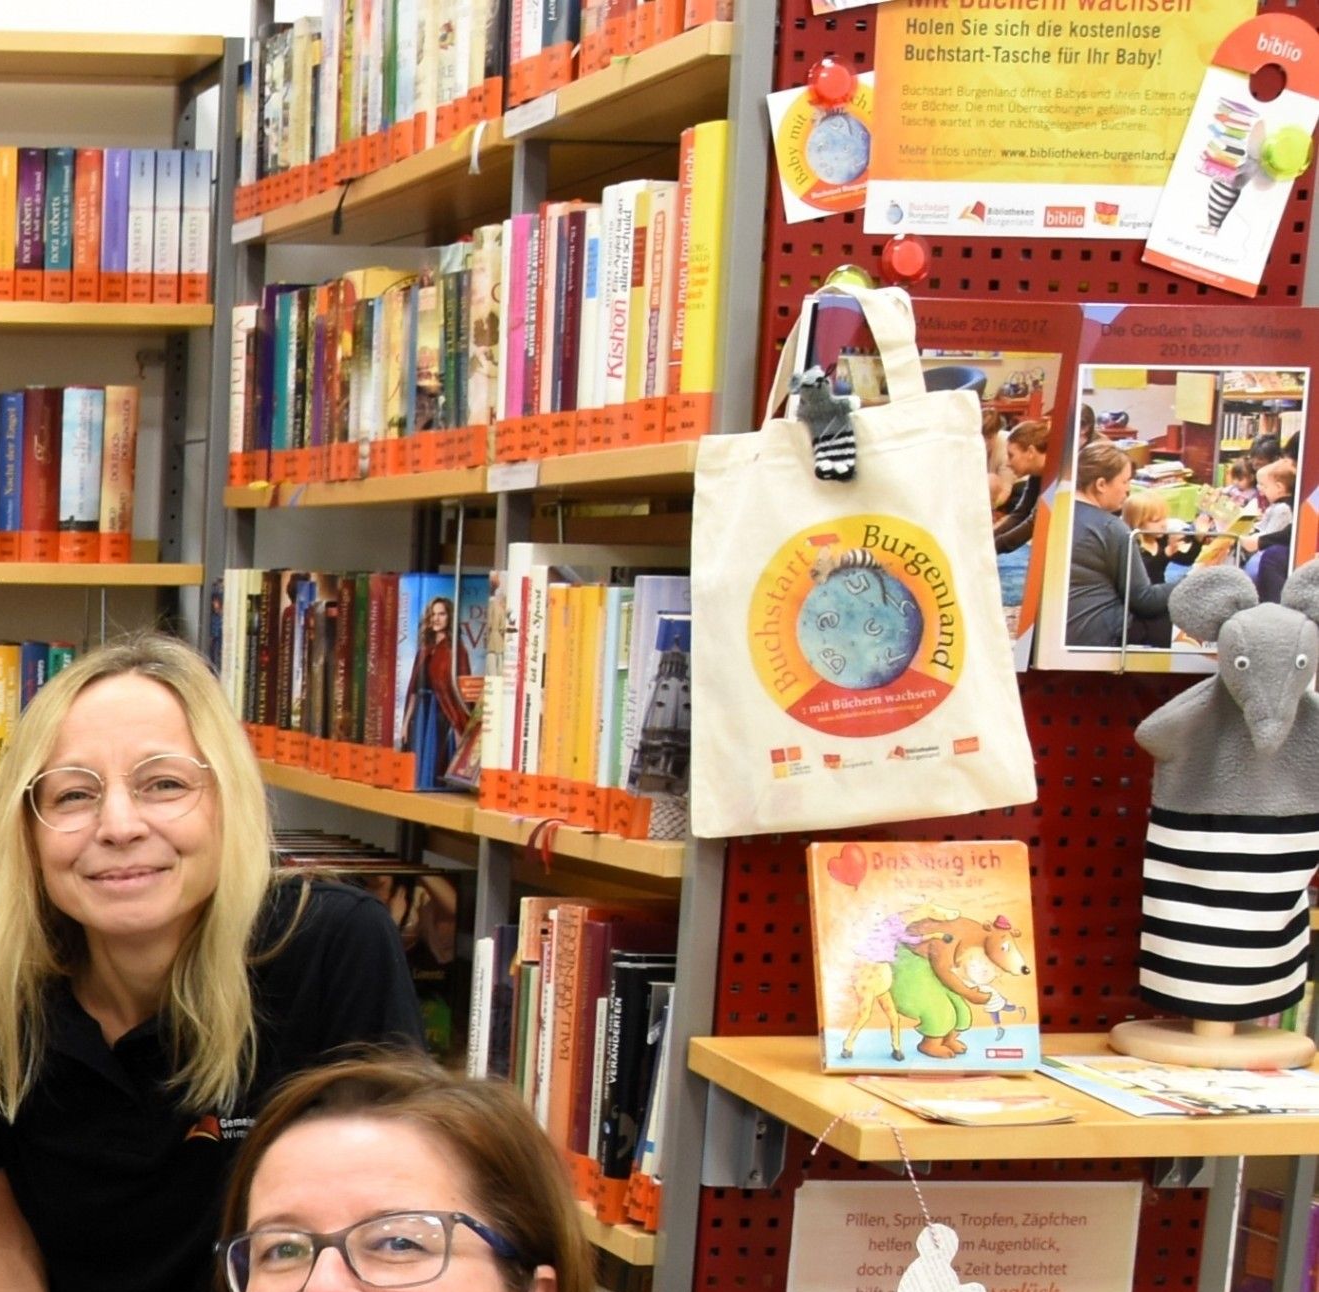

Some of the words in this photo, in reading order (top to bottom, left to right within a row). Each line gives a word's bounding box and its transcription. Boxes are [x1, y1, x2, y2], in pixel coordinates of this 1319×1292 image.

[905, 18, 955, 36] Holen
[960, 19, 988, 37] Sie
[994, 20, 1030, 38] sich
[1036, 20, 1062, 39] die
[1068, 21, 1162, 40] kostenlose
[904, 44, 1051, 64] Buchstart-Tasche
[1056, 46, 1080, 66] für
[1087, 47, 1109, 65] Ihr
[1116, 48, 1163, 70] Baby!
[1256, 32, 1303, 63] biblio
[902, 85, 952, 98] Buchstart
[957, 86, 1017, 99] Burgenland
[1055, 88, 1088, 102] Babys
[1090, 89, 1111, 100] und
[900, 101, 918, 112] der
[966, 102, 984, 113] Die
[987, 102, 1004, 113] mit
[1008, 101, 1094, 118] Überraschungen
[901, 115, 936, 128] Tasche
[939, 117, 972, 129] wartet
[976, 117, 986, 129] in
[988, 118, 1006, 129] der
[898, 144, 927, 157] Mehr
[931, 145, 960, 158] Infos
[788, 147, 810, 187] Baby
[22, 197, 32, 235] roberts
[50, 196, 60, 235] roberts
[76, 197, 87, 236] roberts
[986, 206, 1036, 217] Bibliotheken
[1045, 208, 1084, 227] biblio
[677, 193, 693, 262] trotzdem
[22, 239, 30, 263] nora
[50, 239, 59, 263] nora
[676, 267, 688, 303] man
[606, 300, 629, 380] Kishon
[672, 308, 686, 351] Wenn
[1101, 323, 1126, 338] Die
[1130, 323, 1188, 338] Großen
[1159, 342, 1242, 357] 2016/2017
[5, 406, 18, 440] Engel
[4, 442, 16, 462] der
[3, 463, 16, 496] Nacht
[754, 548, 811, 695] Buchstart
[861, 523, 956, 672] Burgenland
[809, 701, 830, 714] mit
[832, 694, 883, 711] Büchern
[885, 688, 937, 704] wachsen
[970, 850, 1002, 870] ich
[845, 1212, 888, 1229] Pillen,
[960, 1212, 1018, 1231] Tropfen,
[1021, 1211, 1087, 1231] Zäpfchen
[868, 1238, 912, 1252] helfen
[978, 1237, 1061, 1257] Augenblick,
[856, 1262, 893, 1277] doch
[964, 1262, 992, 1277] Zeit
[994, 1261, 1067, 1277] betrachtet
